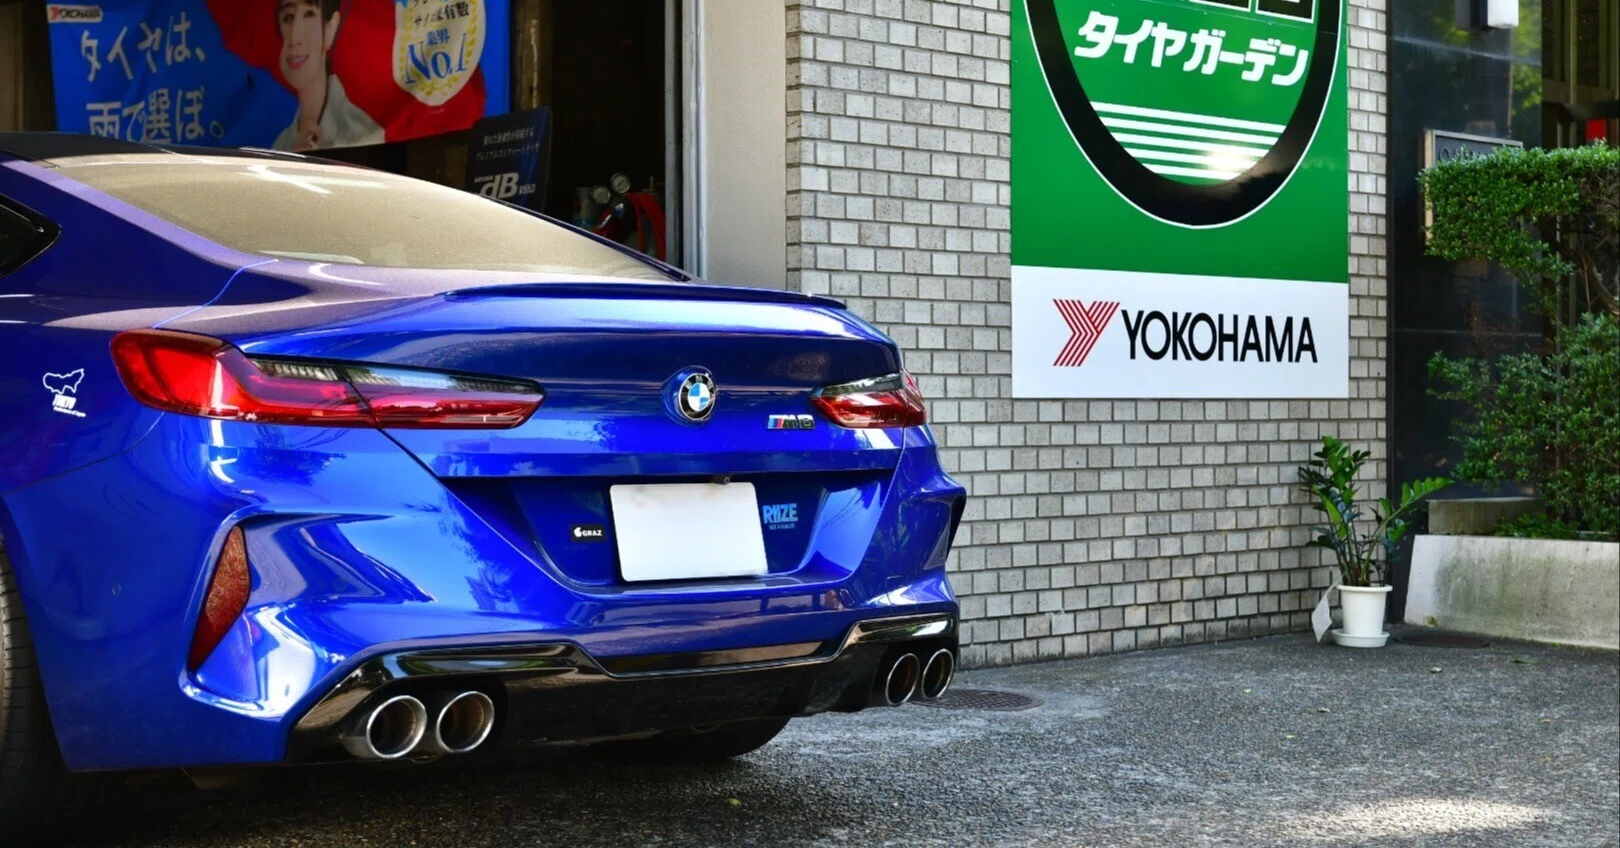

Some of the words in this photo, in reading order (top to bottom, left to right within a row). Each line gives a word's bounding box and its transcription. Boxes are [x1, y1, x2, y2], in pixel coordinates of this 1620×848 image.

[81, 11, 206, 82] タイヤは、
[405, 32, 467, 84] No.1
[1074, 10, 1310, 87] タイヤガーデン
[86, 85, 224, 145] 雨で選ぼ。
[480, 173, 519, 198] dB
[1121, 309, 1318, 364] YOKOHAMA
[775, 414, 815, 430] M8
[582, 529, 603, 537] GRAZ
[762, 503, 798, 524] RIIZE
